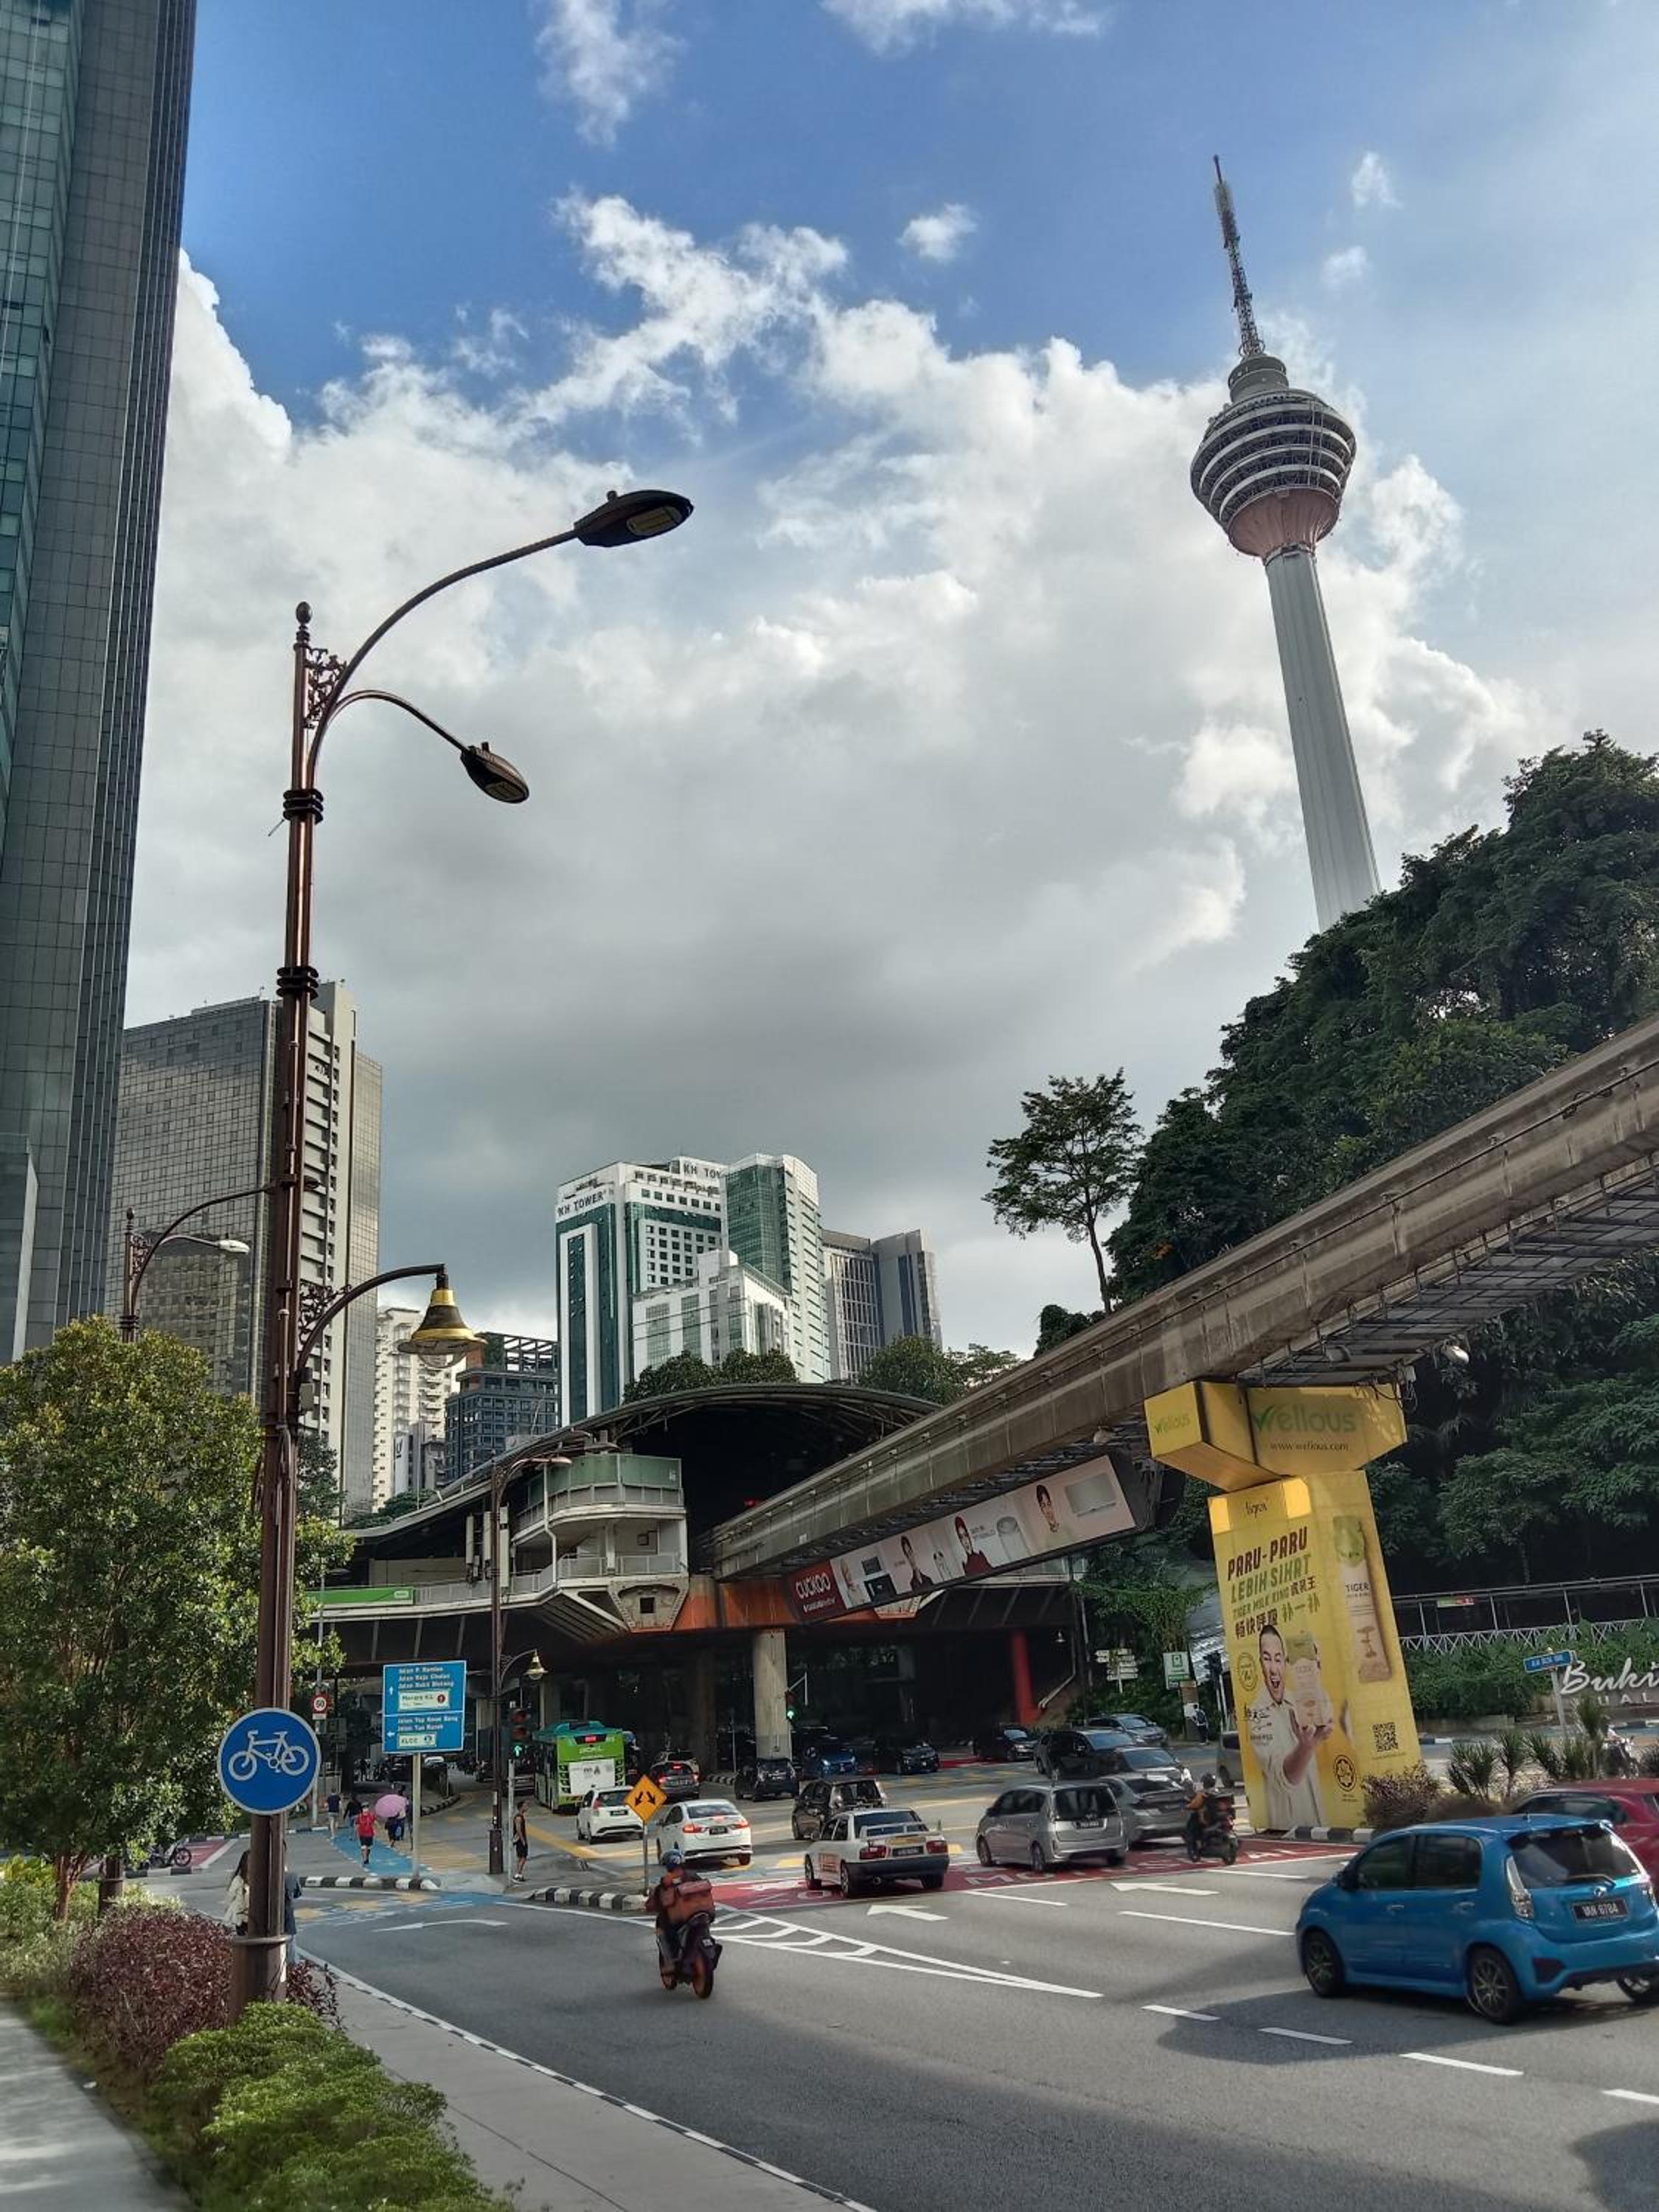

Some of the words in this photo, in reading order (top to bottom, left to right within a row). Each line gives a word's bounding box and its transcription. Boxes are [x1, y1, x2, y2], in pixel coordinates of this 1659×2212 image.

[574, 1192, 604, 1210] TOWER
[1228, 1526, 1307, 1581] PARU-PARU
[796, 1572, 831, 1599] CUCKOO
[1231, 1571, 1267, 1604] LEBIH
[1270, 1554, 1311, 1587] SIHAT
[1345, 1582, 1369, 1593] TIGER
[1232, 1603, 1251, 1618] TIGER
[1253, 1596, 1269, 1612] MILK
[1272, 1586, 1290, 1603] KING
